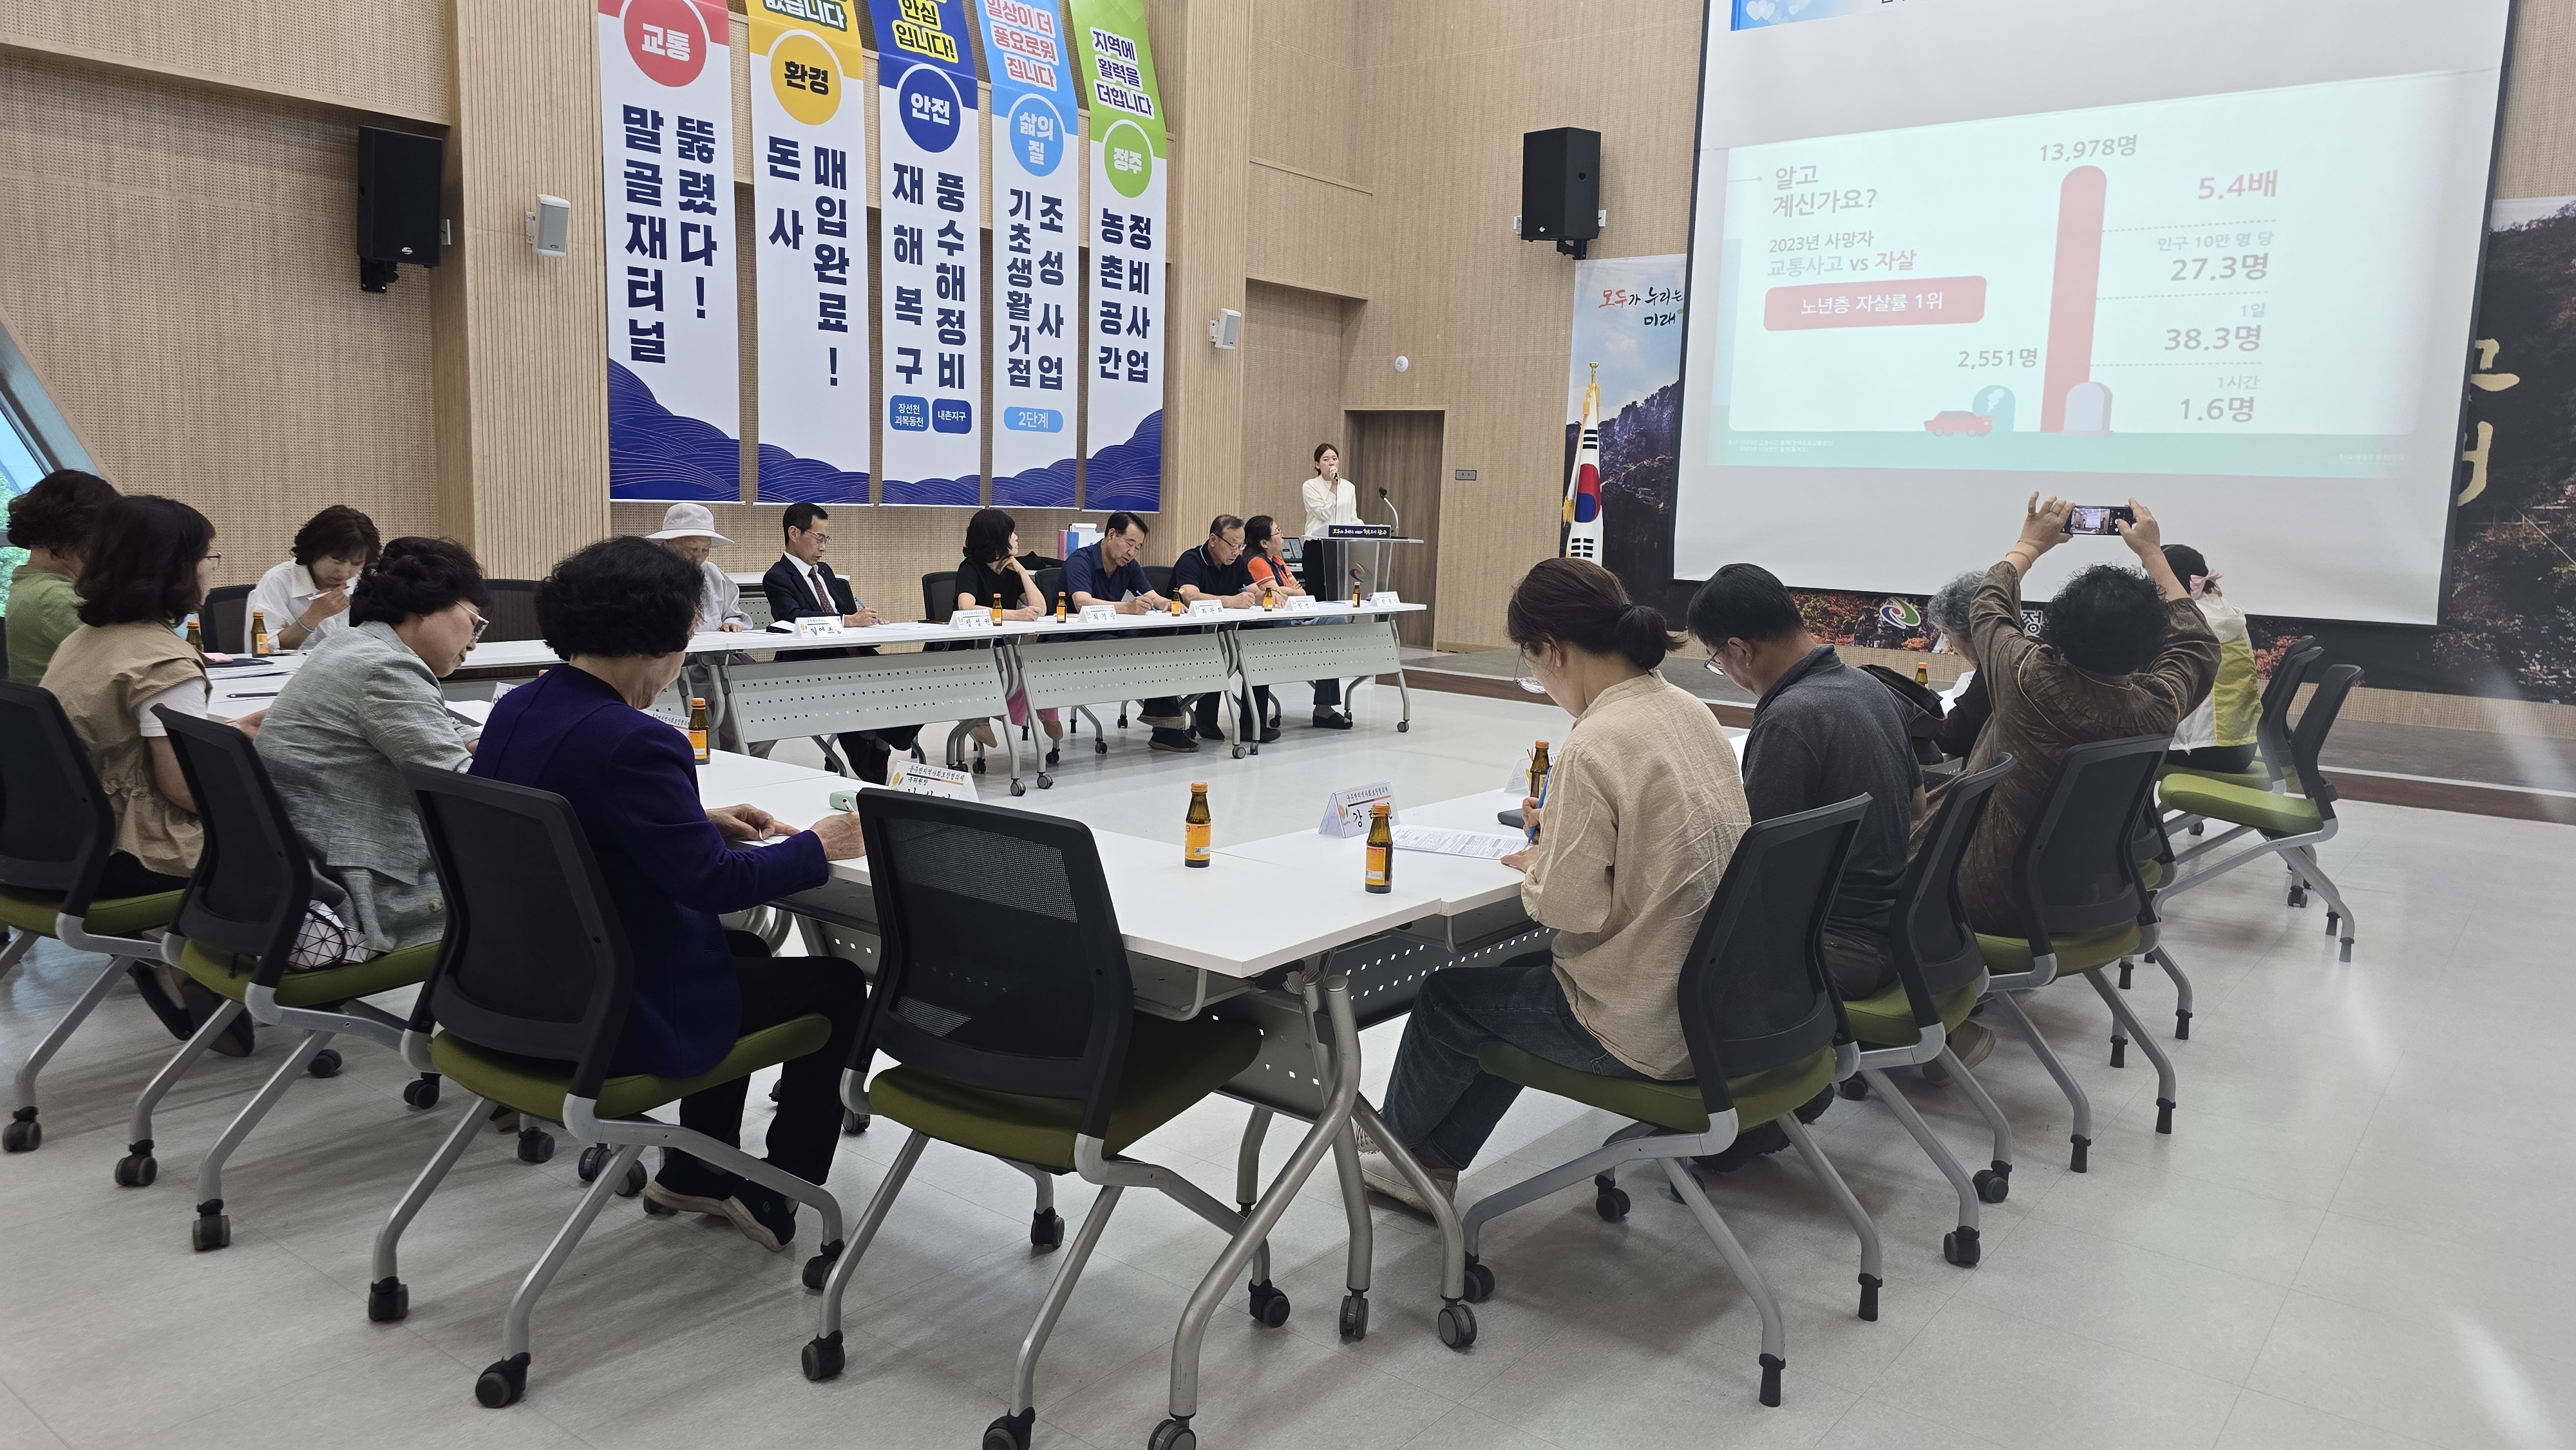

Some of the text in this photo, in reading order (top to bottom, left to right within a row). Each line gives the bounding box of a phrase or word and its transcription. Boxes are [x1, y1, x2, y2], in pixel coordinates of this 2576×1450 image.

[902, 0, 938, 26] 안심
[987, 0, 1053, 34] 일상이 더
[641, 23, 690, 62] 교통
[896, 24, 955, 59] 입니다!
[994, 25, 1056, 62] 풍요로워
[1093, 30, 1135, 61] 지역에
[784, 61, 829, 96] 환경
[1007, 57, 1054, 88] 집니다
[1097, 58, 1141, 88] 활력을
[910, 93, 951, 126] 안전
[1096, 83, 1152, 117] 더합니다
[1019, 112, 1054, 141] 삶의
[1028, 140, 1045, 165] 질
[1113, 147, 1142, 174] 정주
[2040, 135, 2137, 162] 13,978명
[1776, 165, 1819, 190] 알고
[2198, 169, 2278, 200] 5.4배
[767, 136, 804, 250] 돈사
[1772, 189, 1877, 218] 계신가요?
[676, 115, 717, 319] 뚫렸다!
[623, 104, 667, 364] 말골재터널
[1769, 230, 1875, 253] 2023년 사망자
[2157, 231, 2275, 252] 인구 10만 명 당
[813, 146, 850, 386] 매입완료!
[892, 162, 923, 384] 재해복구
[1767, 256, 1844, 278] 교통사고
[1875, 249, 1917, 271] 자살
[2170, 252, 2269, 281] 27.3명
[936, 172, 967, 390] 풍수해정비
[1006, 189, 1033, 388] 기초생활거점
[1037, 194, 1064, 391] 조성사업
[1098, 208, 1124, 380] 농촌공간
[1126, 214, 1151, 384] 정비사업
[1598, 287, 1683, 308] 모두가 누리는
[1801, 292, 1944, 315] 노년층 자살률 1위
[2241, 303, 2266, 318] 1일
[1643, 312, 1676, 326] 미래
[2164, 325, 2262, 352] 38.3명
[1957, 347, 2038, 370] 2,551명
[2217, 375, 2260, 390] 1시간
[895, 415, 924, 427] 괴목동천
[898, 403, 920, 415] 장선천
[938, 410, 967, 422] 내촌지구
[1018, 411, 1048, 429] 2단계
[2179, 395, 2255, 423] 1.6명
